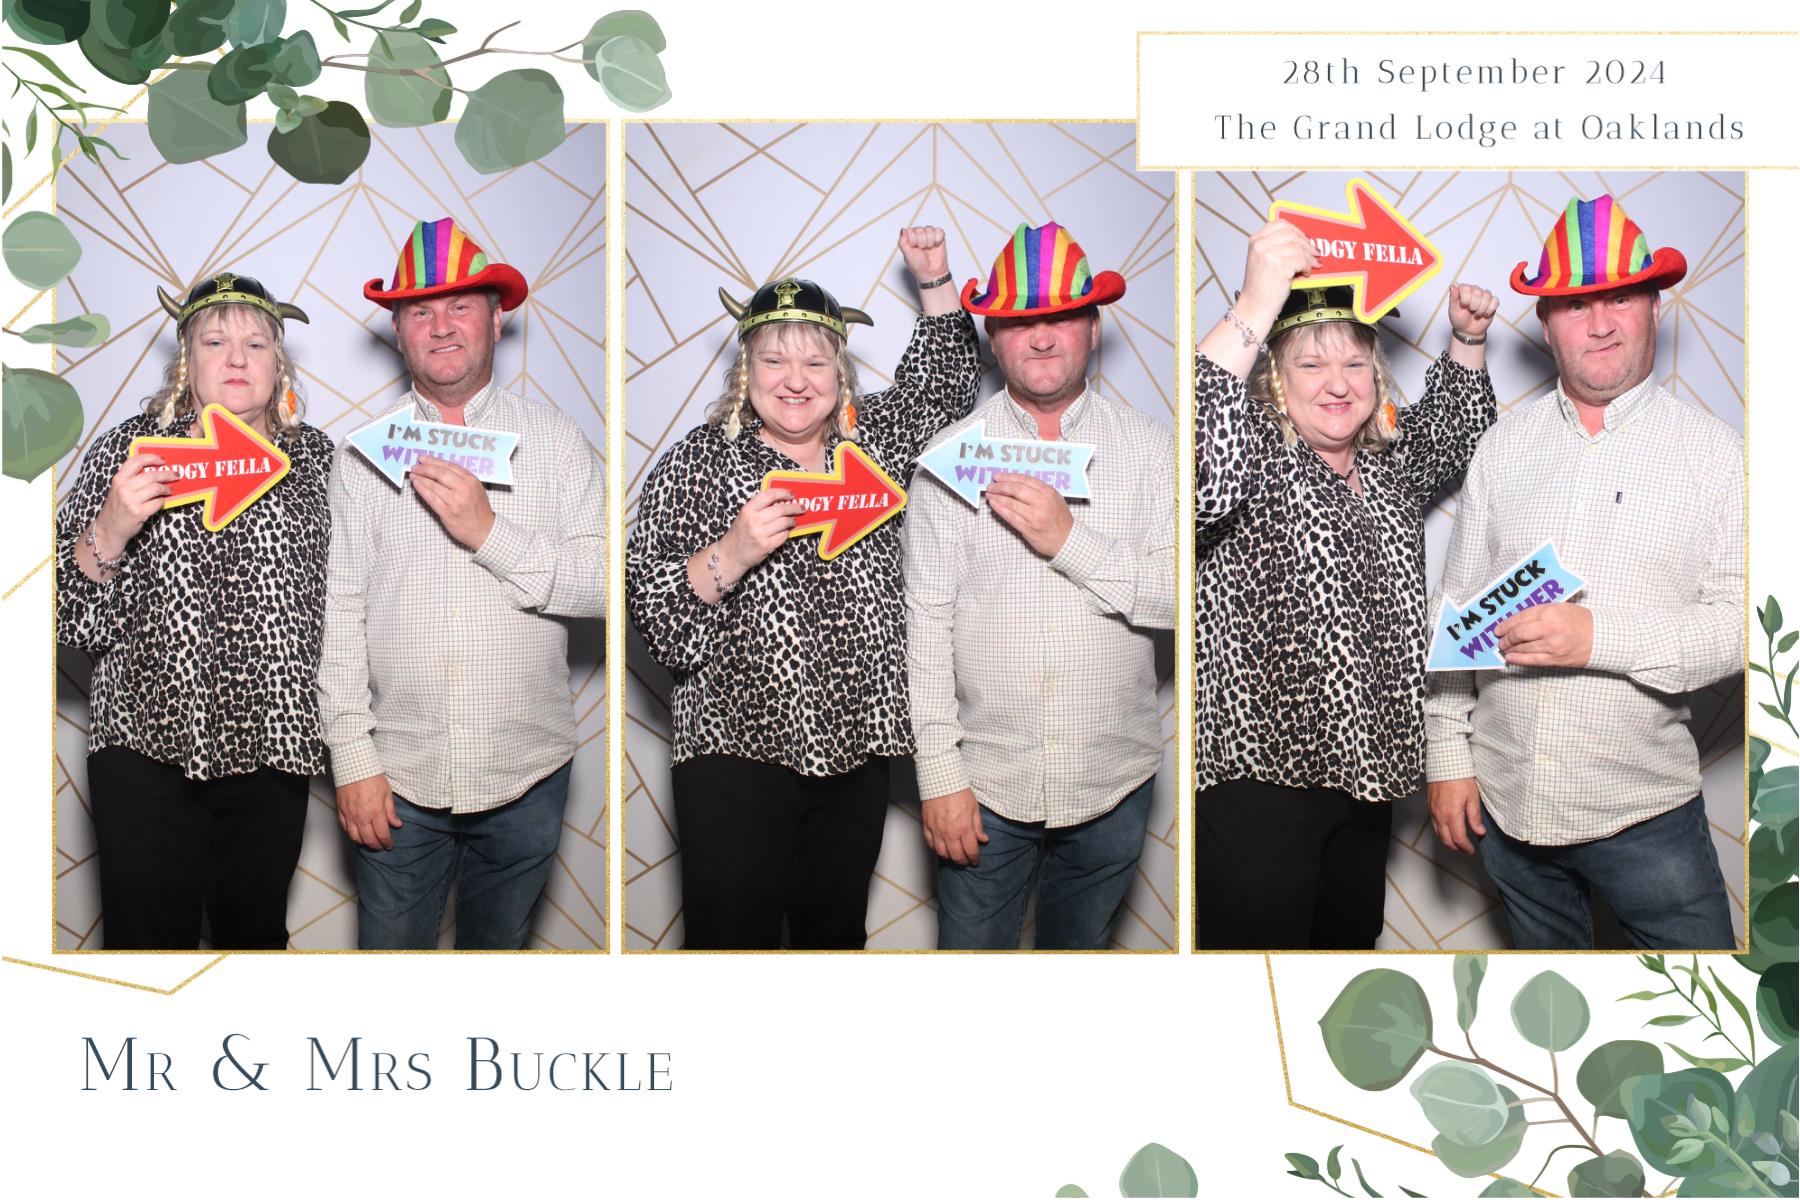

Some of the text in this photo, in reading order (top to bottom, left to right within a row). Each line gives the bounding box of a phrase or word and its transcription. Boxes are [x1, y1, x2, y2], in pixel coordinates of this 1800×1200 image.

[1309, 237, 1424, 266] DGY FELLA
[387, 423, 498, 451] I'M STUCK
[215, 456, 271, 477] FELLA
[959, 441, 1072, 466] I'M STUCK
[954, 464, 1019, 485] WIT
[779, 492, 889, 512] DGY FELLA
[1446, 559, 1546, 642] I'M STUCK
[1459, 610, 1513, 660] WIT
